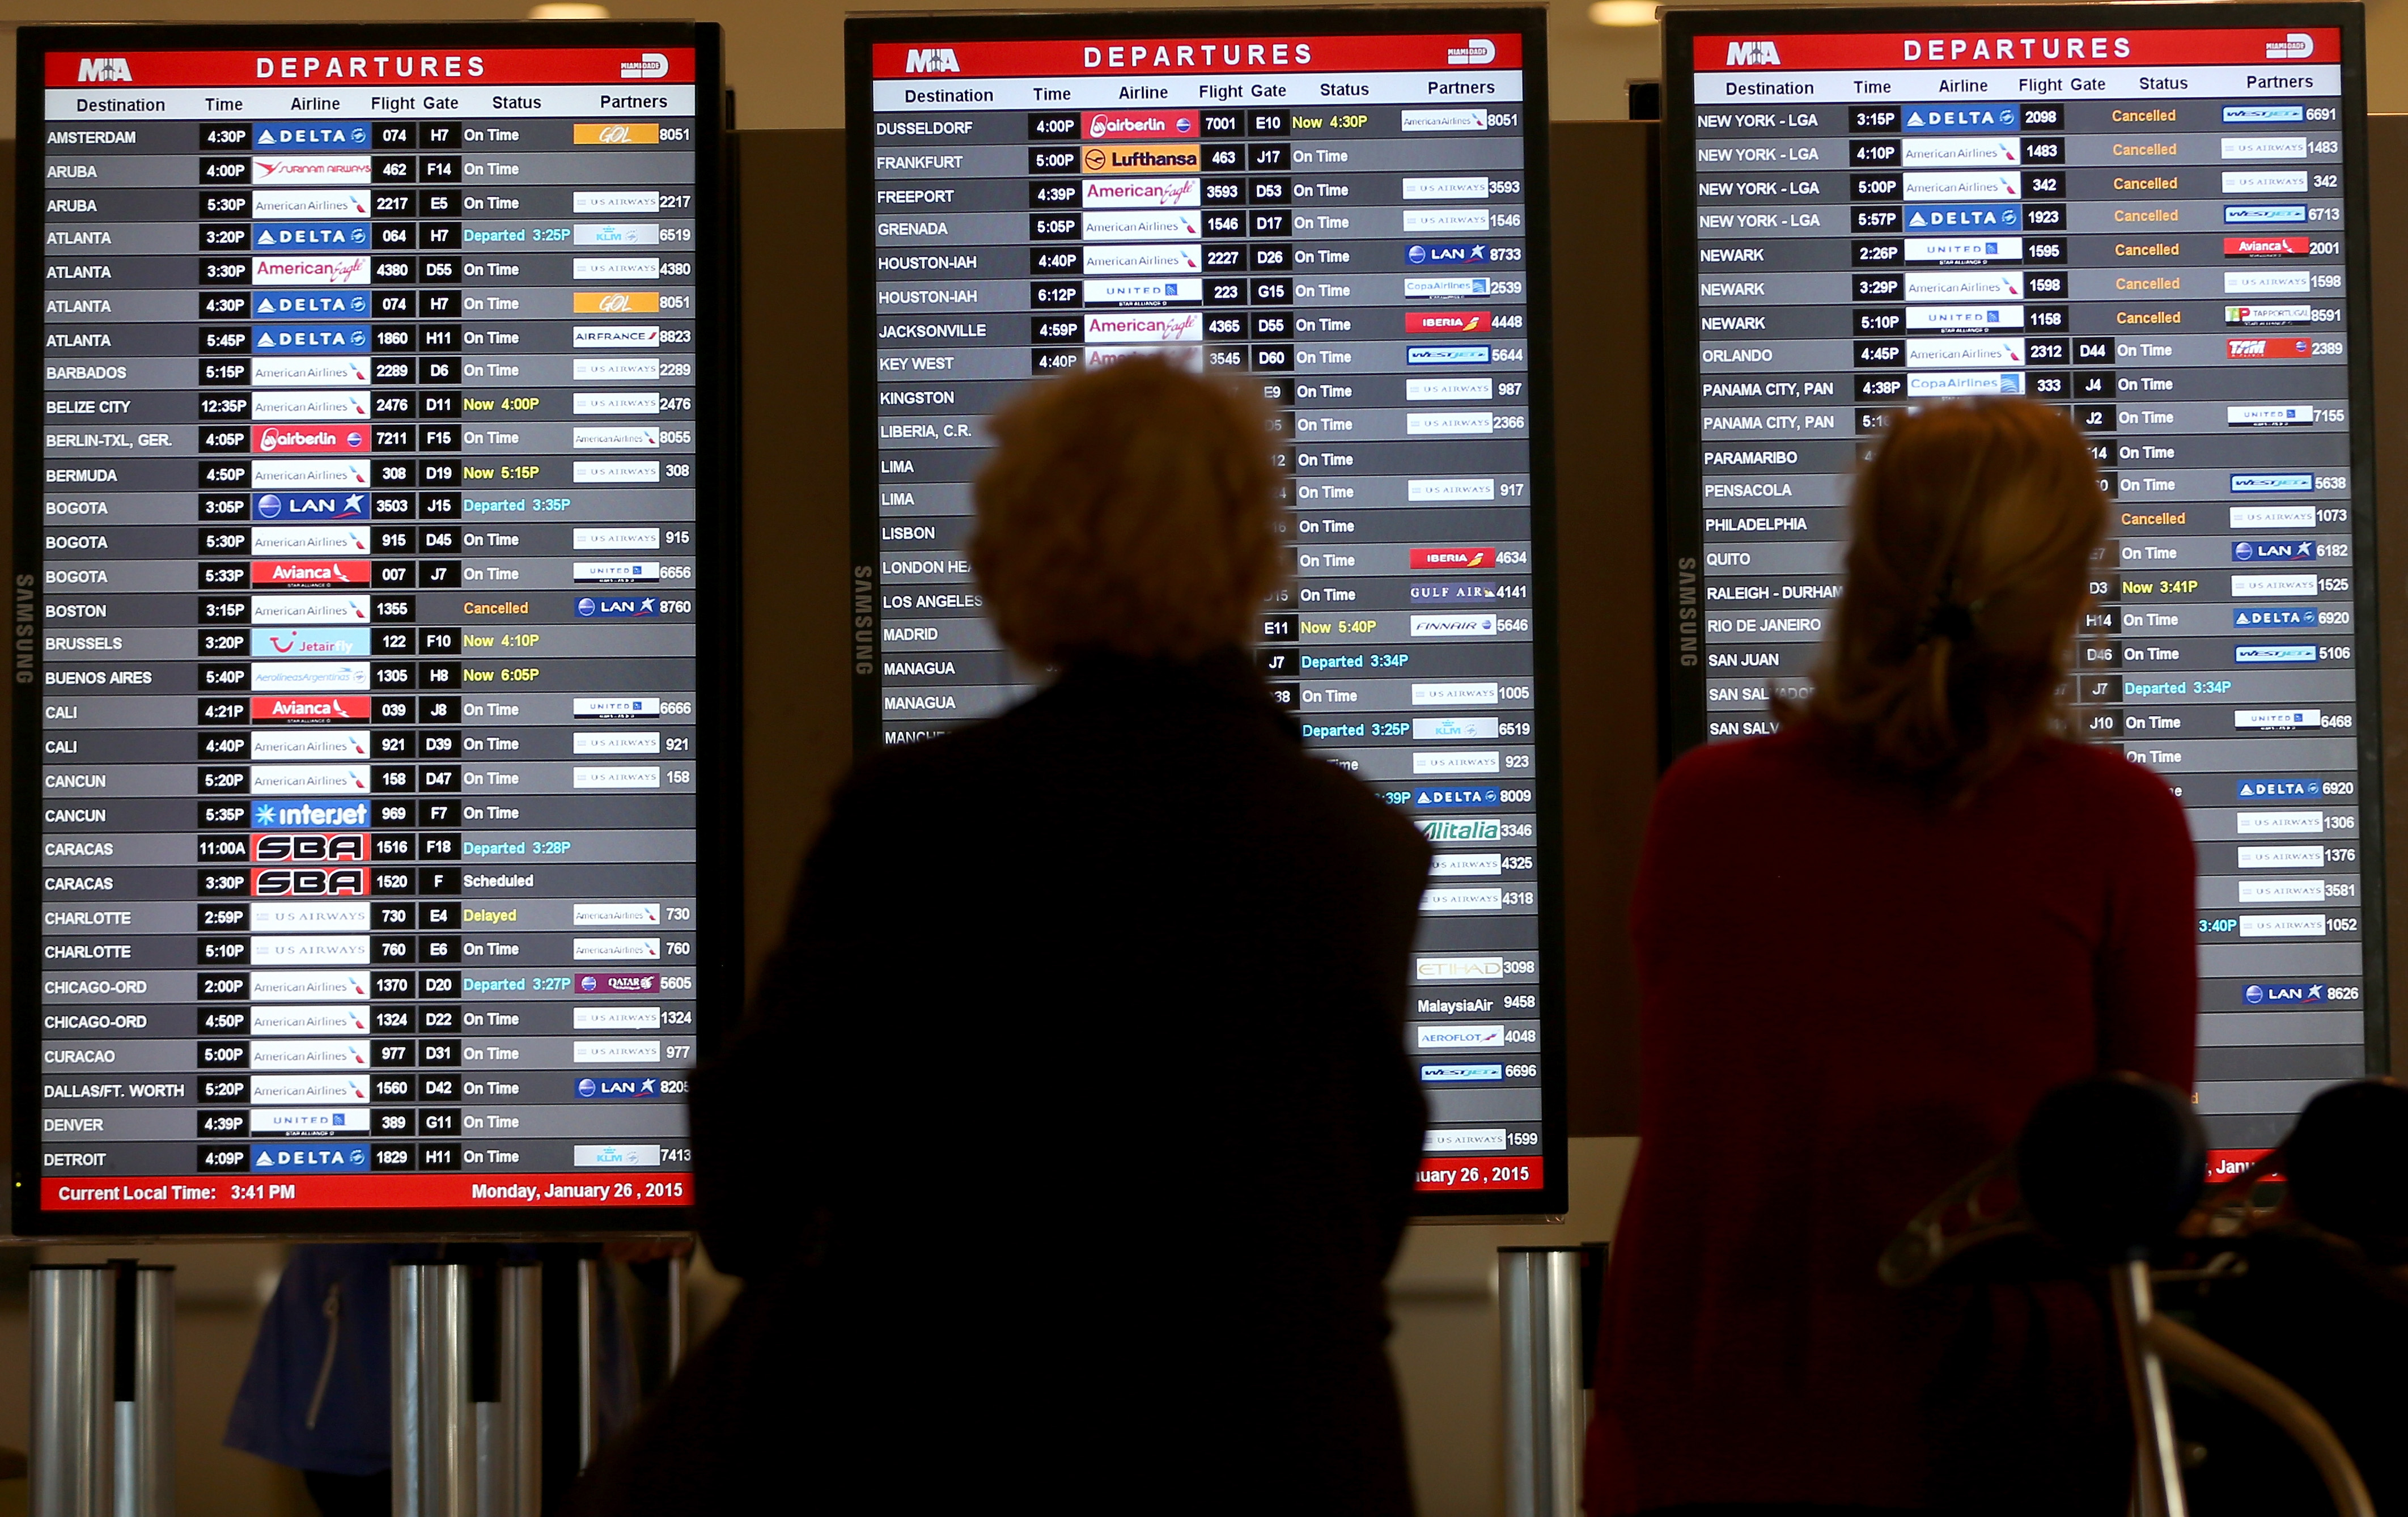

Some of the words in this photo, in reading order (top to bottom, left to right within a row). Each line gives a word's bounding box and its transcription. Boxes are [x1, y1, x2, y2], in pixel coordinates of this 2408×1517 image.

[1084, 44, 1311, 67] DEPARTURES
[1904, 37, 2130, 61] DEPARTURES
[257, 56, 484, 78] DEPARTURES
[905, 89, 993, 103] Destination
[1033, 88, 1071, 101] Time
[1119, 86, 1168, 99] Airline
[1199, 84, 1243, 101] Flight
[1251, 84, 1286, 97] Gate
[1320, 83, 1369, 96] Status
[1428, 82, 1495, 94] Partners
[1726, 82, 1813, 95] Destination
[1854, 80, 1891, 94] Time
[1939, 79, 1988, 92] Airline
[2019, 78, 2062, 95] Flight
[2071, 78, 2105, 91] Gate
[2140, 77, 2188, 90] Status
[2247, 75, 2313, 88] Partners
[77, 98, 165, 112] Destination
[205, 98, 243, 111] Time
[291, 97, 340, 110] Airline
[372, 96, 415, 111] Flight
[423, 96, 459, 109] Gate
[493, 96, 541, 109] Status
[601, 95, 667, 108] Partners
[1698, 115, 1732, 128] NEW
[1735, 114, 1775, 127] YORK
[1788, 113, 1818, 126] LGA
[1856, 112, 1895, 125] 3:15P
[1929, 111, 1994, 125] DELTA
[2025, 111, 2057, 124] 2098
[2112, 109, 2176, 122] Cancelled
[2306, 108, 2336, 120] 6691
[47, 131, 136, 144] AMSTERDAM
[207, 130, 246, 143] 4:30P
[280, 130, 346, 142] DELTA
[383, 129, 406, 142] 074
[431, 129, 449, 141] H7
[464, 129, 484, 141] On
[487, 129, 519, 141] Time
[599, 126, 632, 143] GOL
[660, 128, 689, 141] 8051
[877, 155, 963, 170] FRANKFURT
[1036, 154, 1074, 167] 5:00P
[1112, 151, 1197, 167] Lufthansa
[1212, 151, 1236, 164] 463
[1257, 150, 1281, 163] J17
[1293, 150, 1312, 163] On
[1316, 150, 1348, 162] Time
[46, 232, 112, 244] ATLANTA
[206, 231, 245, 243] 3:20P
[280, 230, 345, 243] DELTA
[382, 230, 406, 242] 064
[431, 229, 449, 241] H7
[464, 229, 525, 244] Departed
[533, 228, 571, 241] 3:25P
[596, 232, 621, 241] KLM
[660, 228, 691, 240] 6519
[1701, 248, 1764, 262] NEWARK
[1860, 247, 1898, 260] 2:26P
[2029, 244, 2060, 257] 1595
[2115, 243, 2179, 256] Cancelled
[2239, 239, 2282, 251] Avianca
[2309, 241, 2339, 255] 2001
[879, 324, 986, 338] JACKSONVILLE
[1040, 323, 1078, 336] 4:59P
[1209, 320, 1240, 333] 4365
[1258, 319, 1284, 332] D55
[1296, 319, 1316, 331] On
[1319, 318, 1351, 331] Time
[1423, 318, 1463, 327] IBERIA
[1491, 315, 1523, 328] 4448
[1702, 349, 1773, 362] ORLANDO
[1861, 347, 1900, 360] 4:45P
[2030, 345, 2062, 358] 2312
[2080, 344, 2106, 357] D44
[2117, 344, 2137, 357] On
[2140, 344, 2172, 356] Time
[2229, 340, 2266, 354] TAM
[2312, 342, 2343, 355] 2389
[46, 502, 108, 514] BOGOTA
[206, 501, 244, 514] 3:05P
[290, 499, 335, 512] LAN
[376, 499, 408, 512] 3503
[427, 499, 451, 512] J15
[464, 499, 525, 514] Departed
[532, 498, 571, 511] 3:35P
[882, 527, 935, 540] LISBON
[1299, 520, 1319, 533] On
[1322, 520, 1355, 532] Time
[1706, 553, 1750, 566] QUITO
[2122, 547, 2142, 560] On
[2144, 546, 2177, 559] Time
[2258, 545, 2291, 556] LAN
[2317, 544, 2348, 557] 6182
[855, 566, 872, 675] SAMSUNG
[1678, 558, 1697, 667] SAMSUNG
[16, 574, 34, 684] SAMSUNG
[884, 628, 938, 641] MADRID
[1264, 621, 1288, 634] E11
[1301, 621, 1332, 634] Now
[1338, 620, 1376, 633] 5:40P
[1497, 619, 1528, 632] 5646
[45, 637, 122, 650] BRUSSELS
[205, 636, 244, 649] 3:20P
[299, 639, 353, 654] Jetairfly
[383, 635, 406, 648] 122
[427, 634, 451, 647] F10
[464, 634, 494, 647] Now
[501, 634, 539, 647] 4:10P
[884, 662, 956, 675] MANAGUA
[1269, 656, 1285, 668] J7
[1301, 655, 1363, 671] Departed
[1371, 654, 1409, 667] 3:34P
[45, 809, 106, 822] CANCUN
[206, 808, 244, 821] 5:35P
[279, 803, 367, 825] interjet
[381, 807, 406, 820] 969
[431, 806, 448, 819] F7
[464, 806, 484, 819] On
[486, 806, 519, 819] Time
[2199, 919, 2237, 932] 3:40P
[1418, 999, 1494, 1015] MalaysiaAir
[1504, 995, 1536, 1008] 9458
[1422, 1034, 1482, 1043] AEROFLOT
[1505, 1031, 1536, 1043] 4048
[1492, 1166, 1529, 1181] 2015
[58, 1187, 120, 1201] Current
[124, 1185, 167, 1200] Local
[172, 1185, 216, 1200] Time:
[231, 1185, 264, 1199] 3:41
[269, 1184, 295, 1199] PM
[472, 1184, 540, 1202] Monday,
[544, 1183, 611, 1201] January
[646, 1183, 682, 1197] 2015
